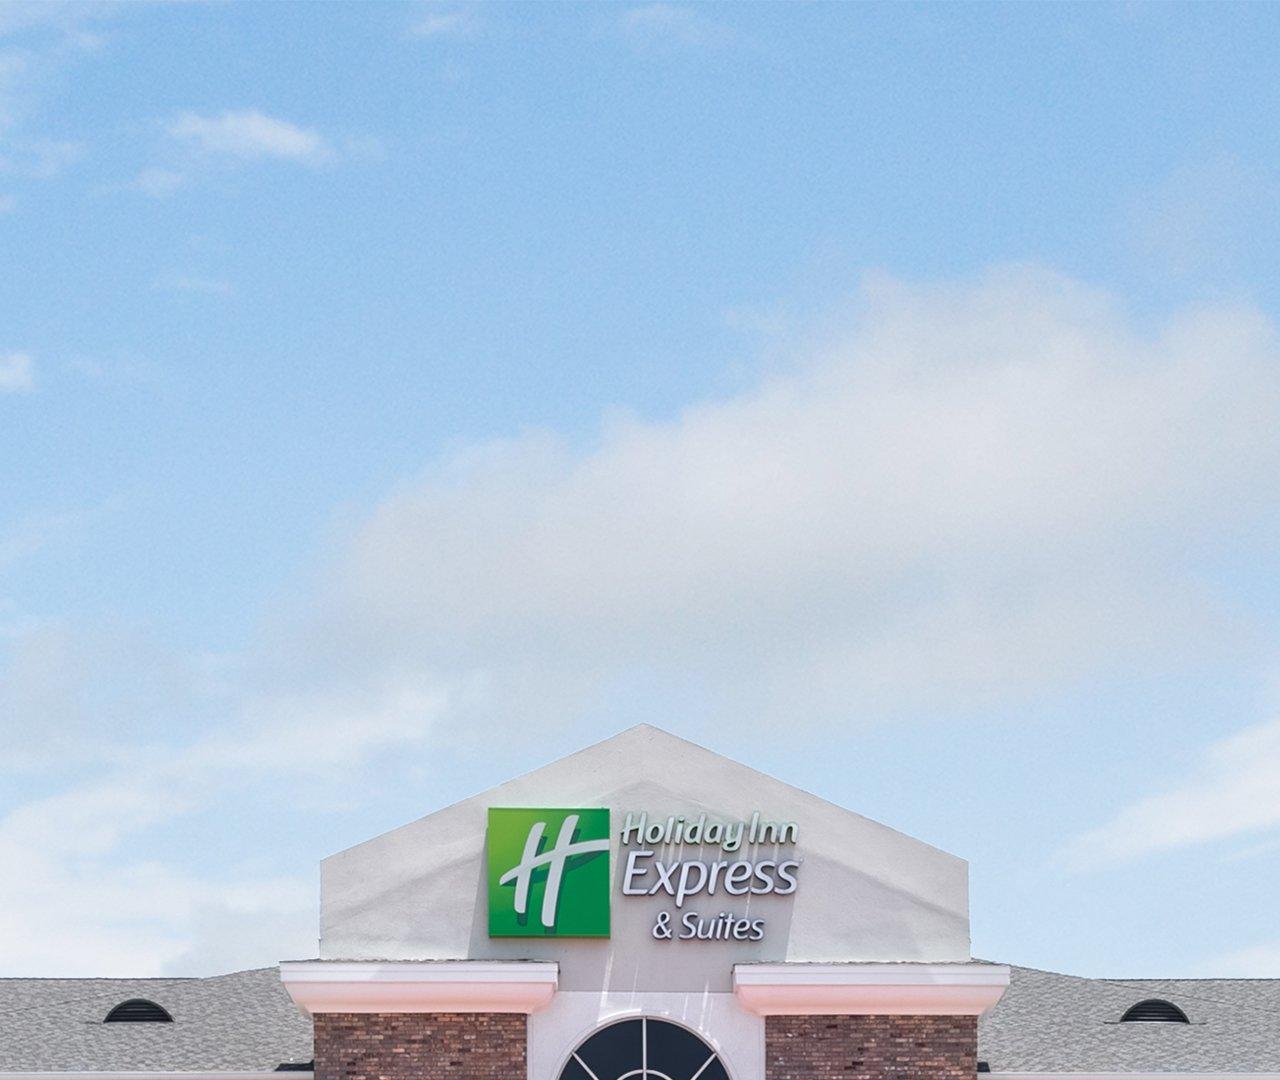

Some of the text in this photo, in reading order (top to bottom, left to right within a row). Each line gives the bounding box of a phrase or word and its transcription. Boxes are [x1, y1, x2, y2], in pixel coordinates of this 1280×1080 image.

[620, 809, 799, 852] Holiday Inn
[622, 850, 800, 907] Express
[652, 911, 765, 941] & Suites
